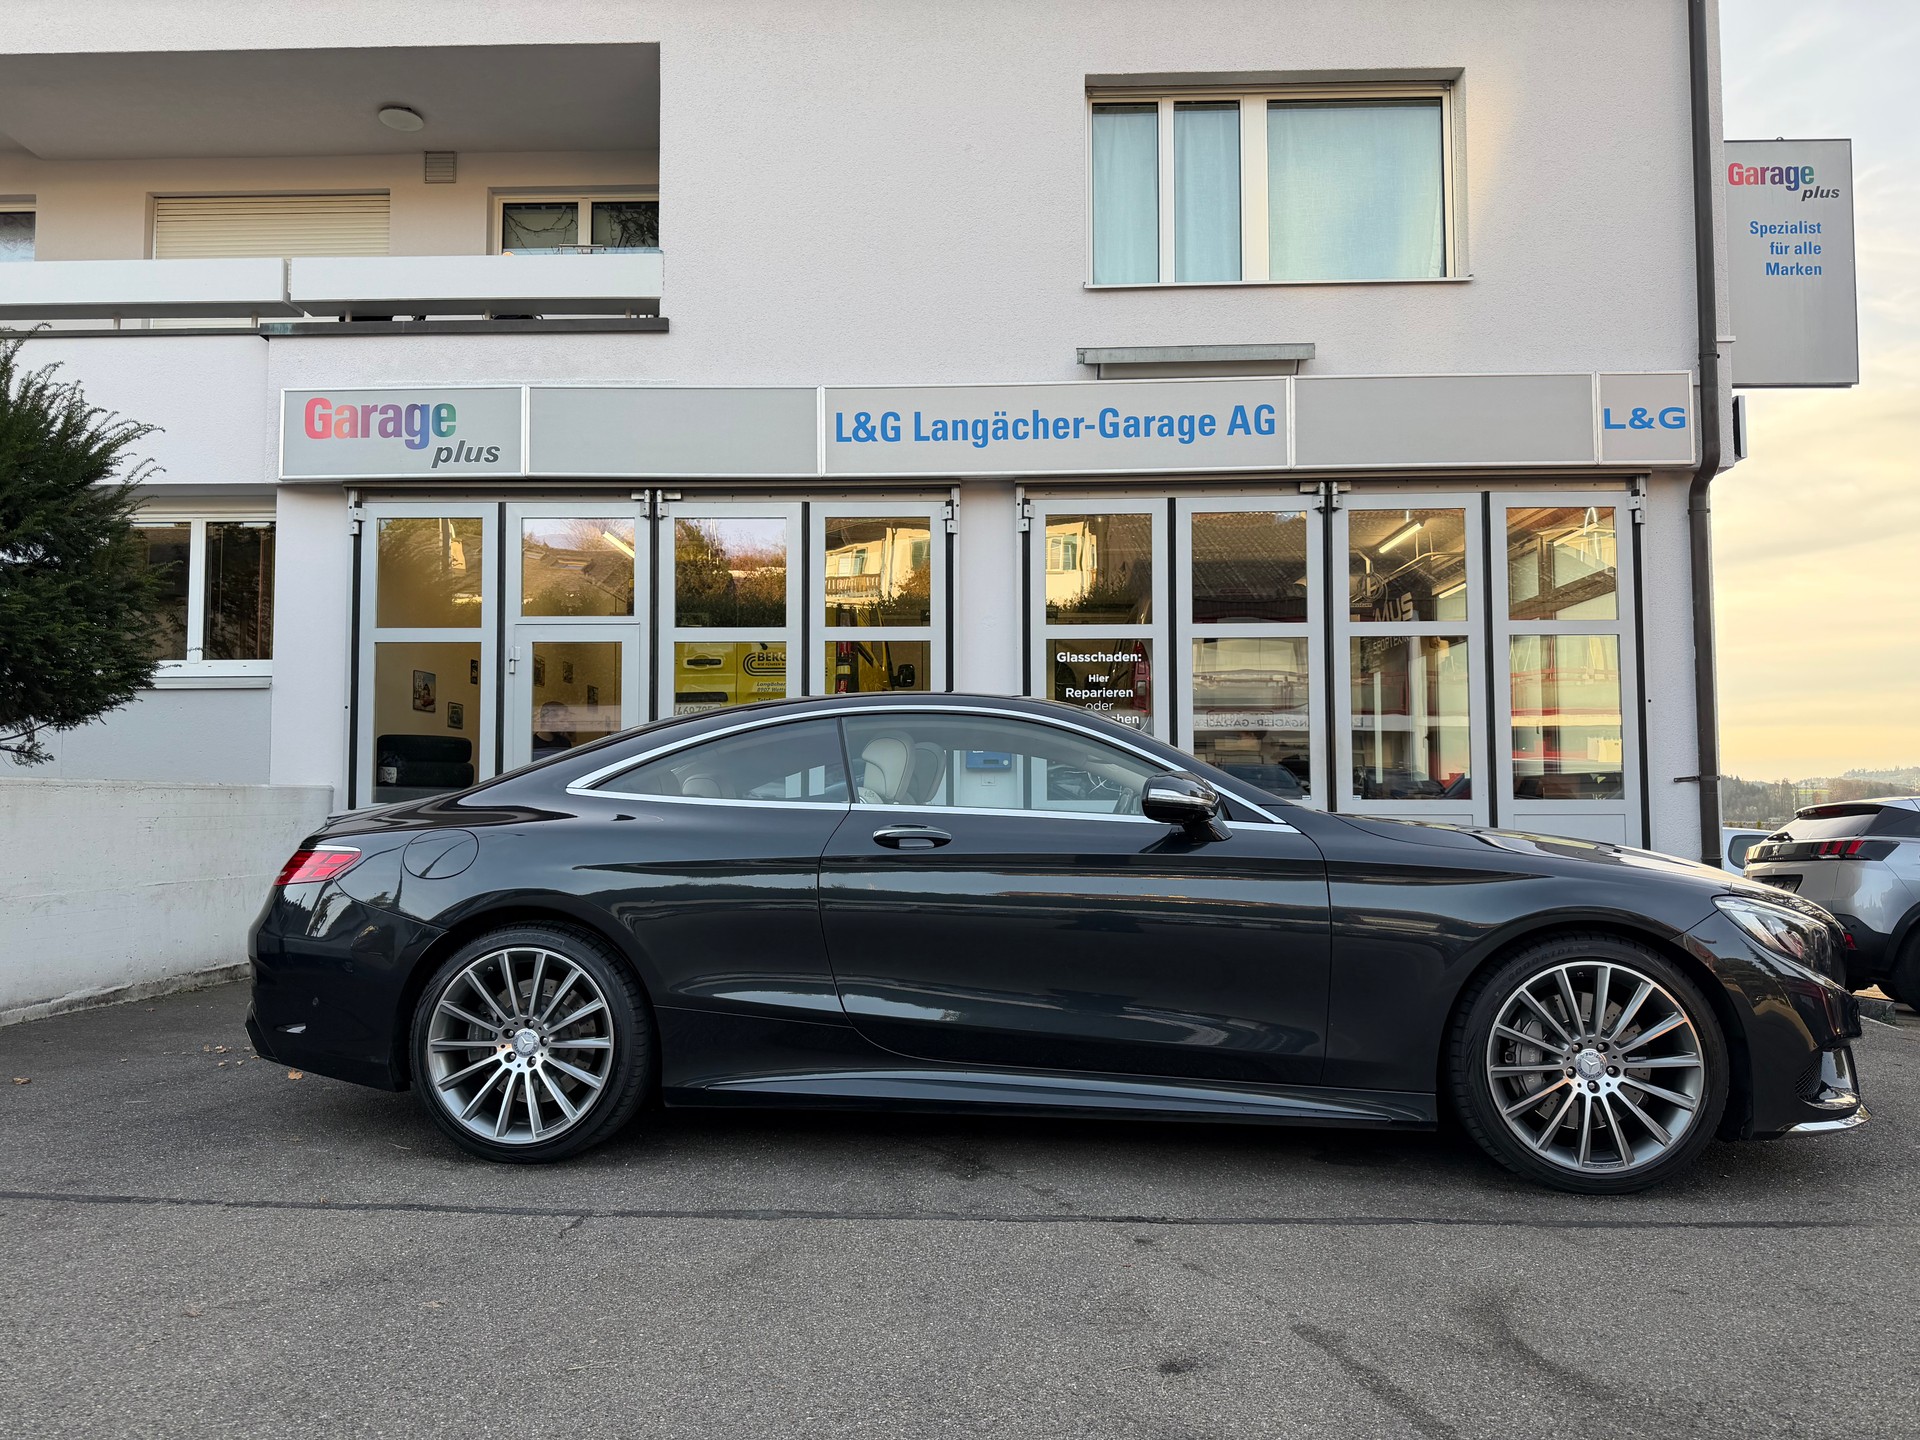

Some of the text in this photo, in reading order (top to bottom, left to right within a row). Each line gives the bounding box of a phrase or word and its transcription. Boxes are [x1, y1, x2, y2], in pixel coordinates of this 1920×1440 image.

[1727, 162, 1815, 191] Garage
[1801, 186, 1840, 202] plus
[1749, 220, 1822, 238] Spezialist
[1769, 241, 1822, 255] für alle
[1765, 262, 1822, 276] Marken
[304, 396, 457, 450] Garage
[835, 404, 1276, 448] L&G Langächer-Garage AG
[1603, 407, 1686, 430] L&G
[430, 440, 501, 469] plus
[1373, 592, 1413, 622] MUS
[1056, 651, 1142, 662] Glasschaden:
[1088, 674, 1109, 682] Hier
[1065, 687, 1133, 699] Reparieren
[1085, 700, 1114, 711] oder
[1111, 713, 1140, 724] hen
